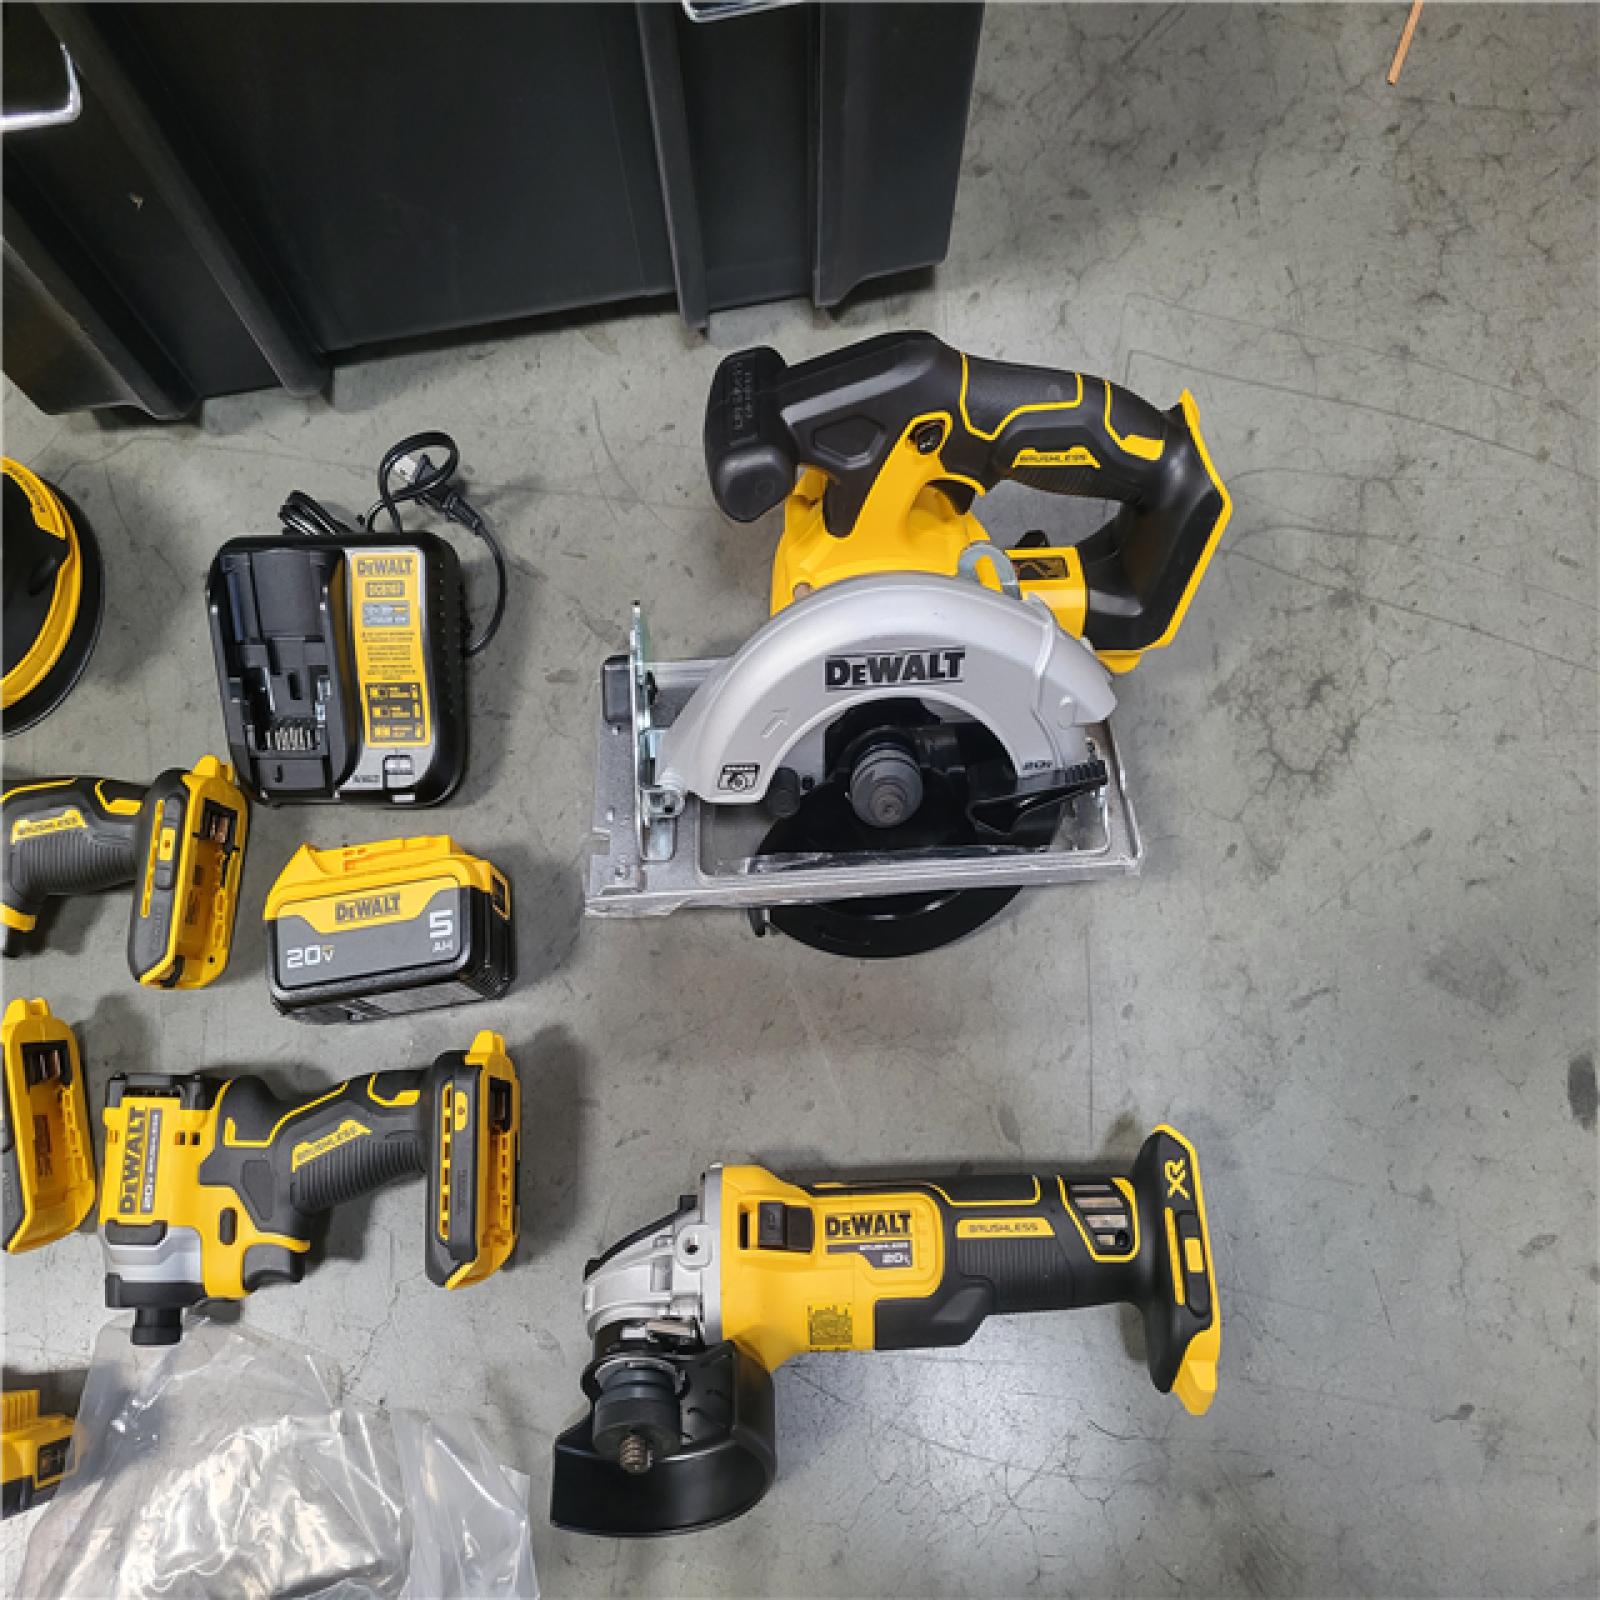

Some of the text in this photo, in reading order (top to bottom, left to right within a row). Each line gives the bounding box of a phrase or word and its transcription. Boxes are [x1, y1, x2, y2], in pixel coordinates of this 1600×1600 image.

[357, 557, 413, 577] DEWALT
[825, 650, 965, 686] DEWALT
[335, 893, 400, 923] DEWALT
[429, 909, 453, 939] 5
[287, 945, 334, 968] 20V
[119, 1106, 146, 1213] DEWALT
[827, 1214, 911, 1236] DEWALT
